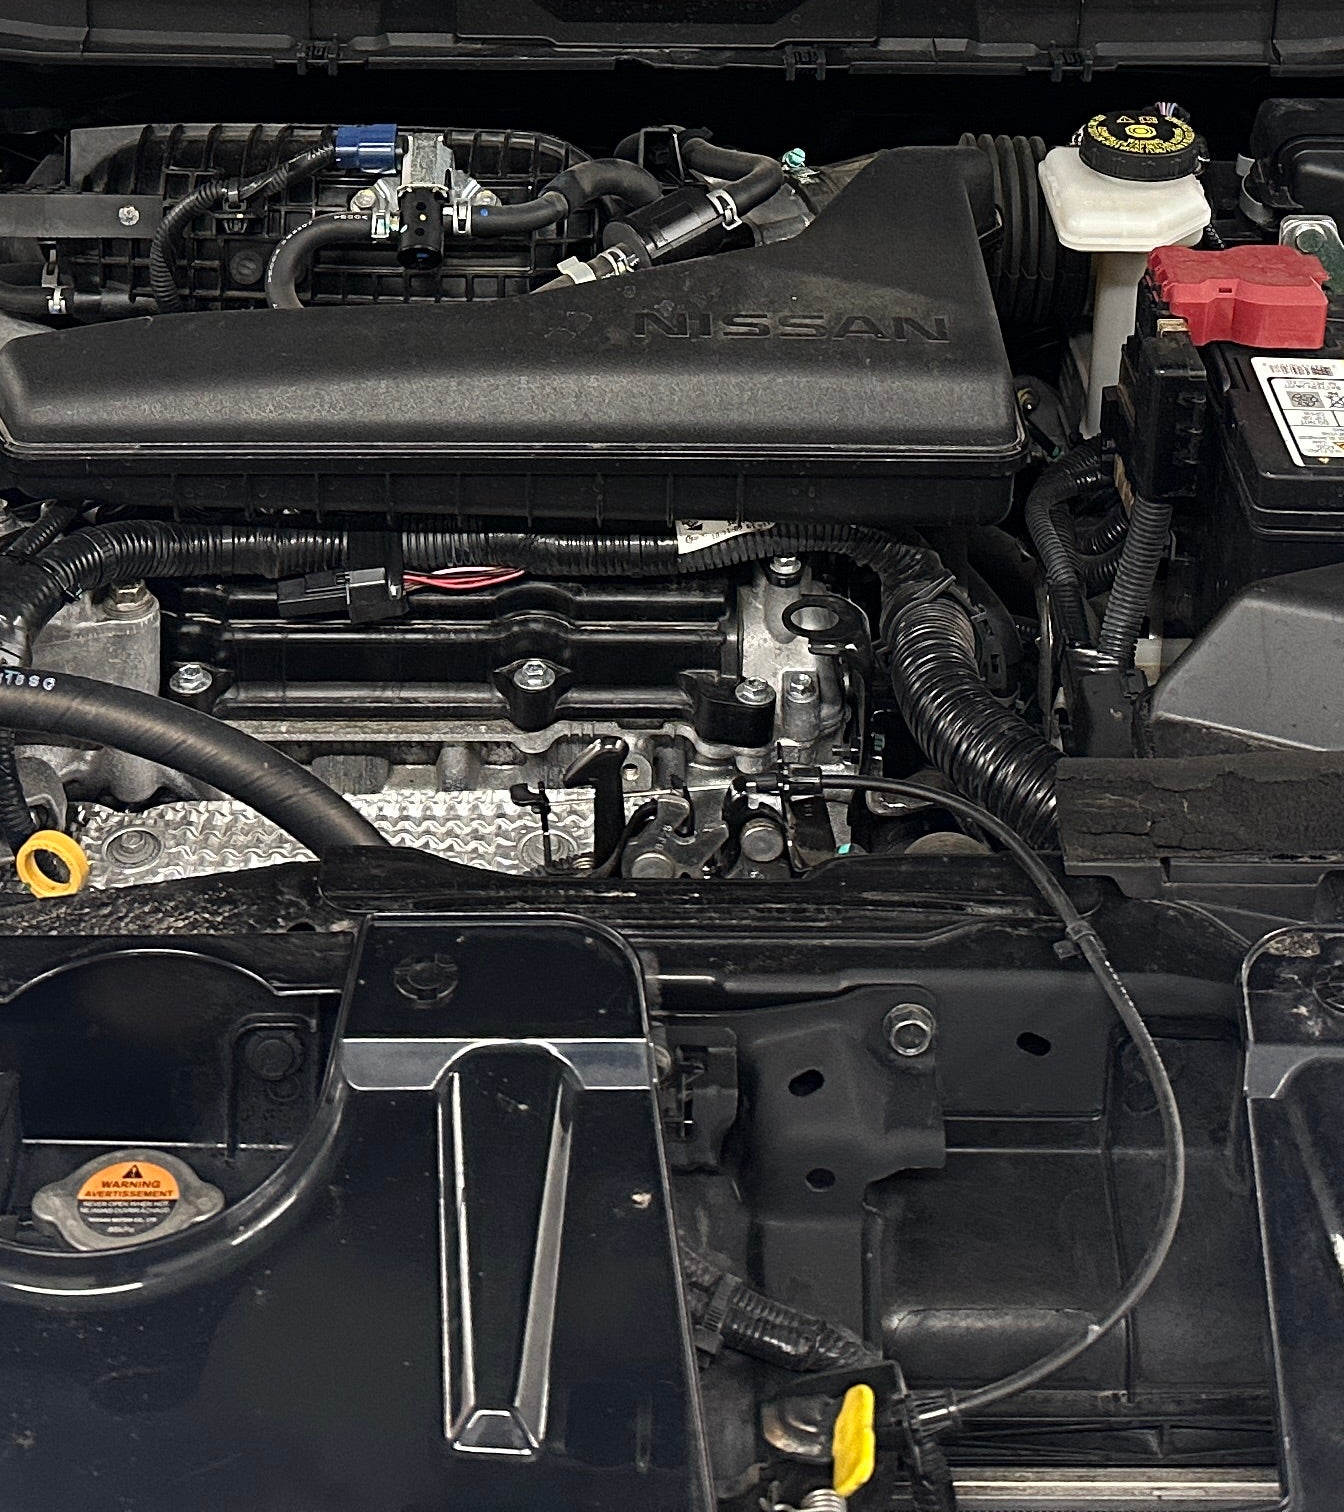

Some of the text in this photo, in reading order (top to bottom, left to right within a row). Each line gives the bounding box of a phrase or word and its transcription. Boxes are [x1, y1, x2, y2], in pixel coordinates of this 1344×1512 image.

[634, 312, 950, 343] NISSAN
[101, 1180, 161, 1189] WARNING
[84, 1189, 173, 1198] AVERTISSEMENT
